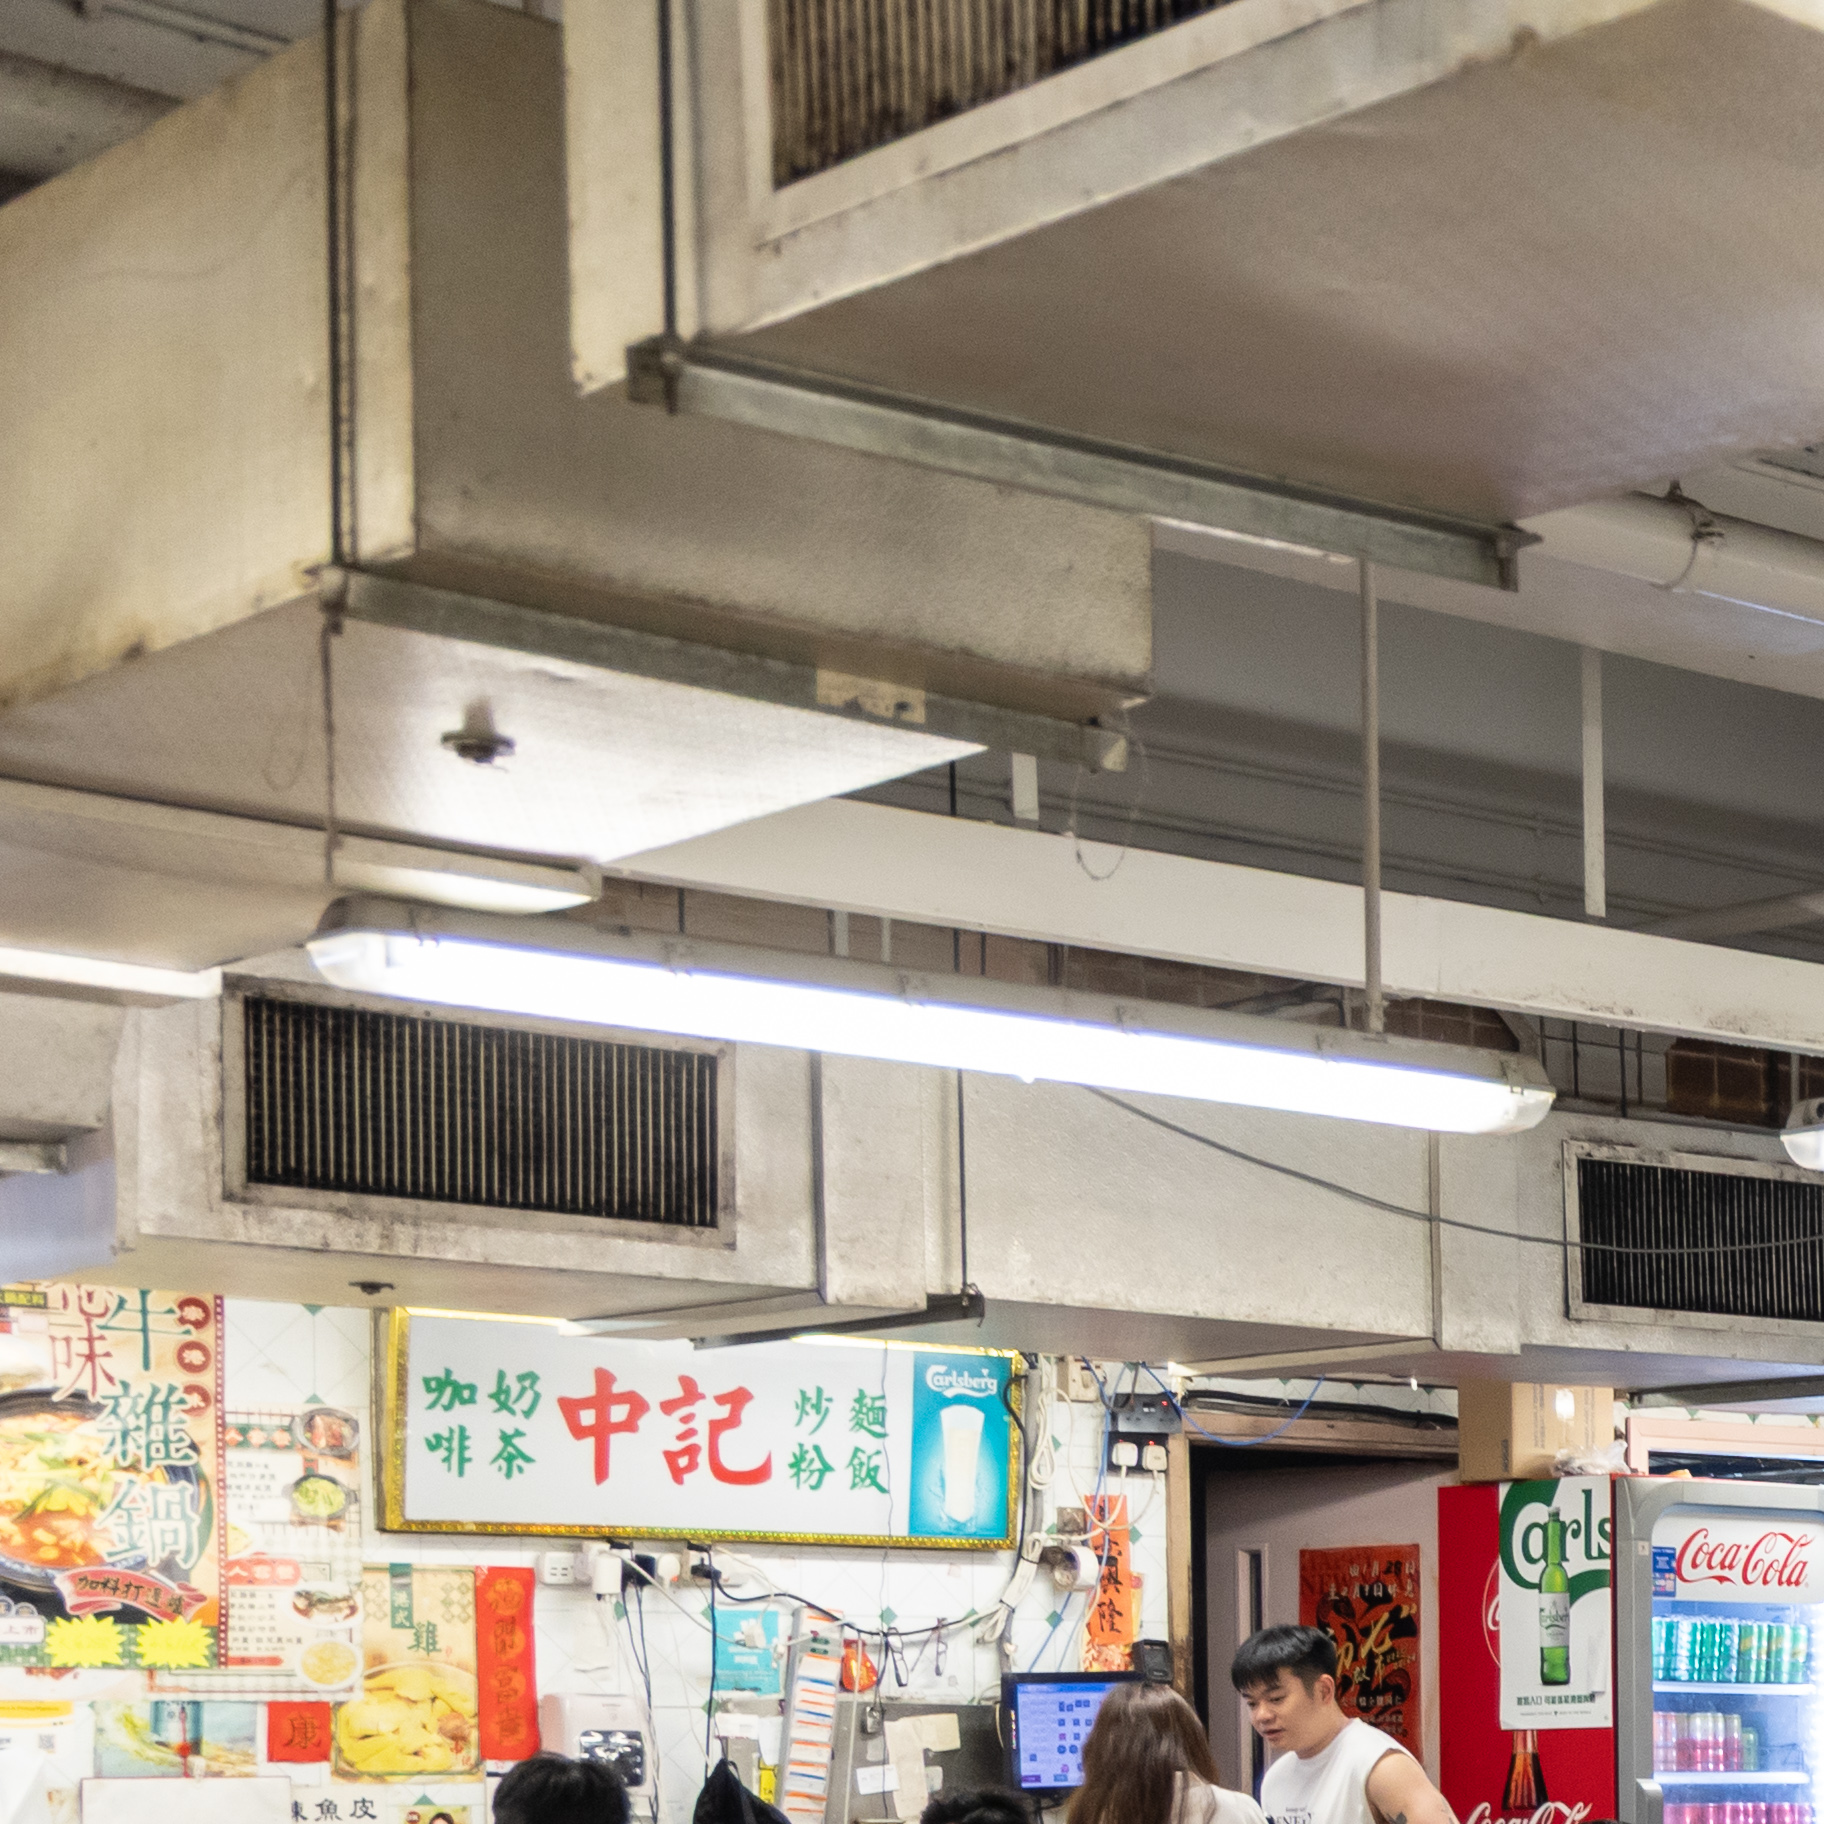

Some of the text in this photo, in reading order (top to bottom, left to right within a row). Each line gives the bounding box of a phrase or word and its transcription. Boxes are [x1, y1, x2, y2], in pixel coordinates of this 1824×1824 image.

[421, 1367, 478, 1478] 咖啡
[488, 1367, 542, 1480] 奶茶
[924, 1363, 998, 1398] Carlsberg
[556, 1366, 773, 1487] 中記
[1676, 1527, 1816, 1588] Coca-Cola
[407, 1620, 442, 1656] 雞
